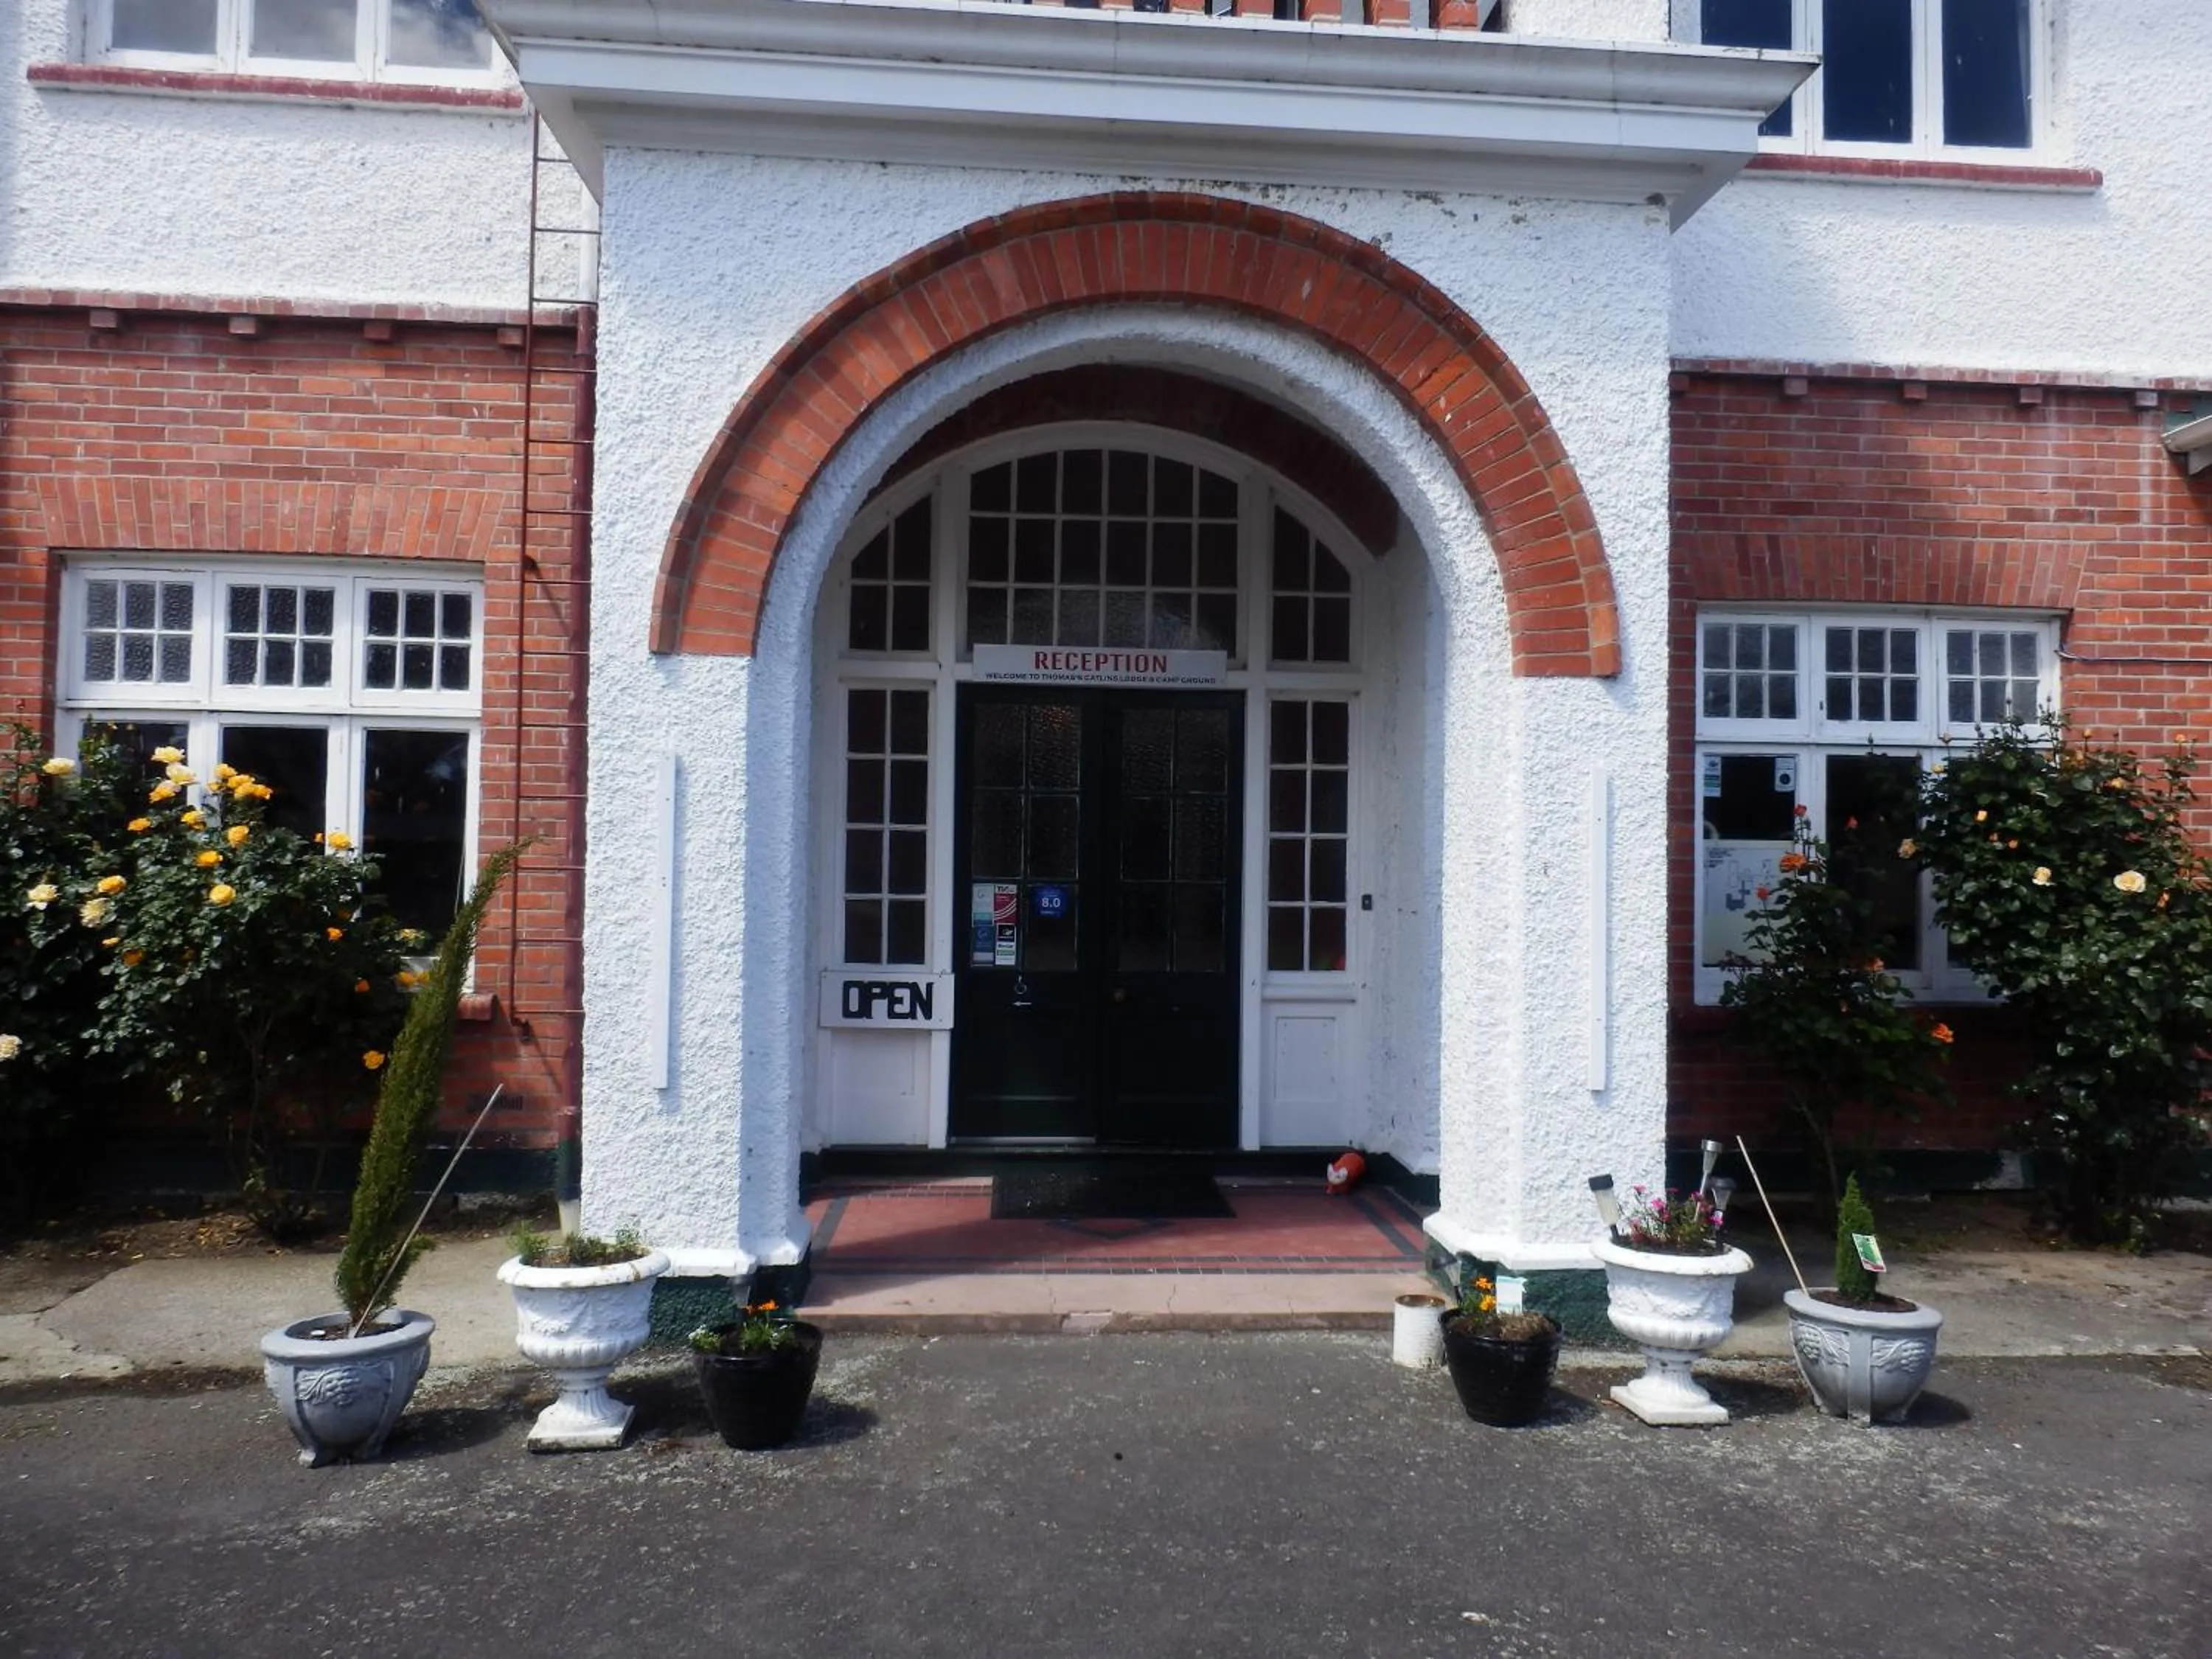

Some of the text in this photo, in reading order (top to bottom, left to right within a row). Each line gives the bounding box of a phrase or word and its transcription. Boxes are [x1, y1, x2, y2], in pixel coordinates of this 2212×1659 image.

[1034, 651, 1167, 673] RECEPTION
[1180, 676, 1217, 684] GROUND
[1041, 897, 1061, 908] 8.0
[842, 981, 934, 1020] OPEN
